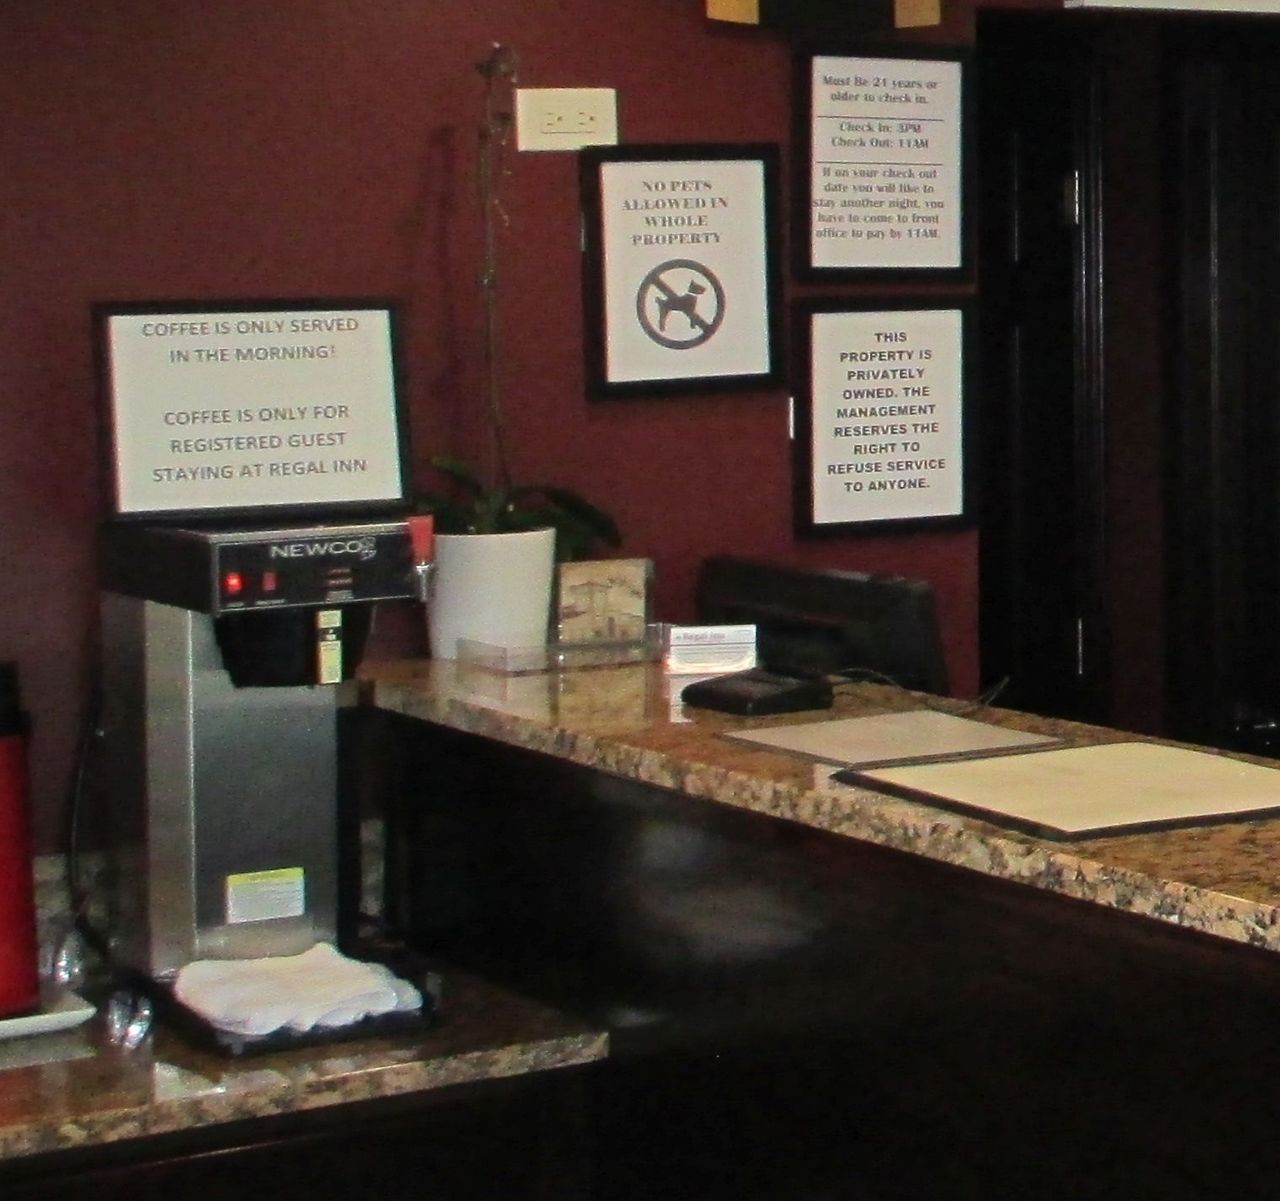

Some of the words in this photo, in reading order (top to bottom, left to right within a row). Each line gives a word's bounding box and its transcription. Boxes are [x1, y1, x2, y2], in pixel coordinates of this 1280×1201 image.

[873, 78, 887, 87] 21
[643, 181, 666, 192] NO
[671, 180, 712, 192] PETS
[622, 198, 706, 211] ALLOWED
[711, 197, 728, 208] IN
[645, 216, 708, 227] WHOLE
[632, 232, 721, 245] PROPERTY
[142, 322, 209, 337] COFFEE
[215, 321, 230, 335] IS
[236, 320, 285, 335] ONLY
[290, 318, 359, 333] SERVED
[875, 332, 907, 343] THIS
[170, 349, 190, 363] IN
[196, 348, 229, 362] THE
[236, 345, 335, 362] MORNING!
[840, 350, 914, 362] PROPERTY
[920, 349, 932, 360] IS
[847, 368, 925, 381] PRIVATELY
[843, 388, 898, 400] OWNED.
[903, 386, 930, 397] THE
[164, 410, 231, 426] COFFEE
[238, 409, 253, 423] IS
[259, 407, 307, 422] ONLY
[314, 405, 350, 420] FOR
[837, 404, 936, 419] MANAGEMENT
[835, 424, 907, 437] RESERVES
[912, 423, 939, 433] THE
[170, 435, 282, 454] REGISTERED
[288, 432, 348, 448] GUEST
[854, 443, 897, 455] RIGHT
[902, 442, 920, 452] TO
[152, 465, 233, 482] STAYING
[239, 463, 263, 478] AT
[270, 461, 328, 476] REGAL
[333, 459, 367, 473] INN
[828, 462, 882, 474] REFUSE
[887, 459, 946, 471] SERVICE
[844, 481, 863, 492] TO
[869, 478, 930, 491] ANYONE.
[270, 540, 360, 559] NEWCO
